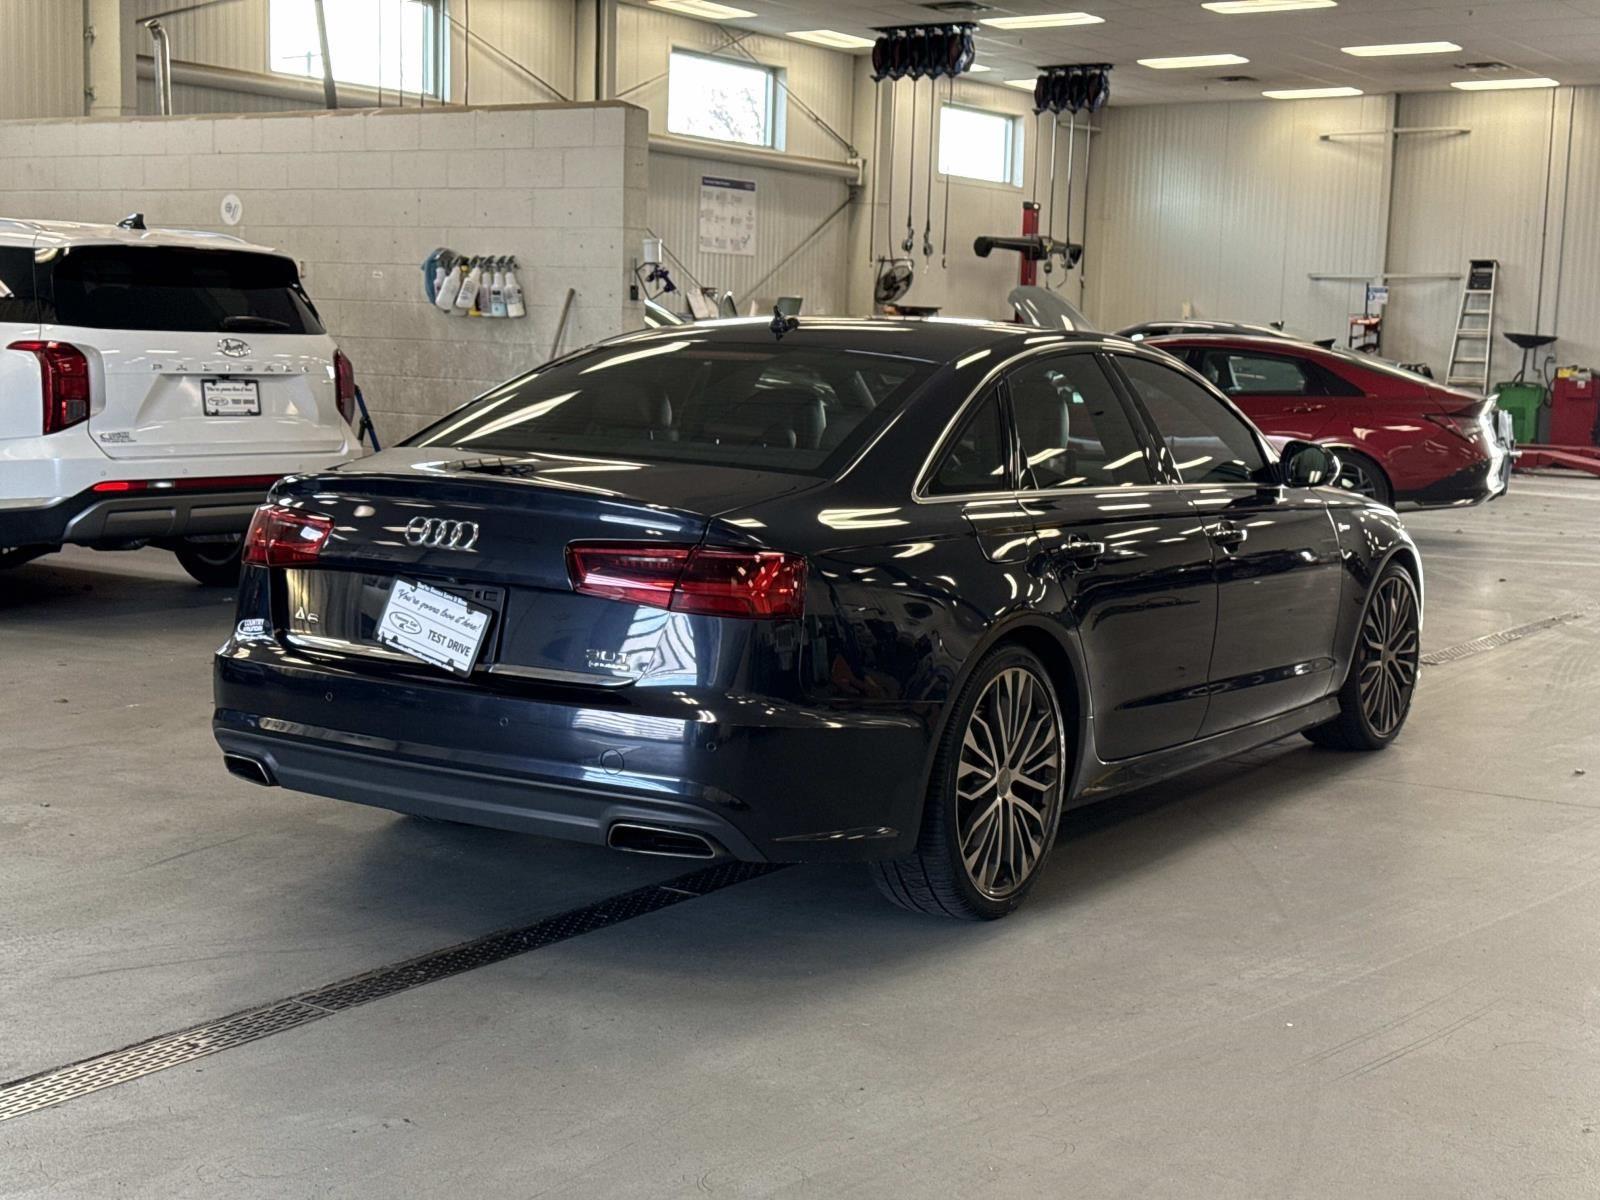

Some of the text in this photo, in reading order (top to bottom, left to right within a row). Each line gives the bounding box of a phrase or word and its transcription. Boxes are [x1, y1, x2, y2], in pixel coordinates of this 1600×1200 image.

[295, 606, 319, 623] A6
[397, 588, 420, 605] You're
[418, 602, 441, 616] gonna
[440, 608, 455, 621] love
[427, 629, 447, 646] TEST
[447, 639, 472, 657] DRIVE
